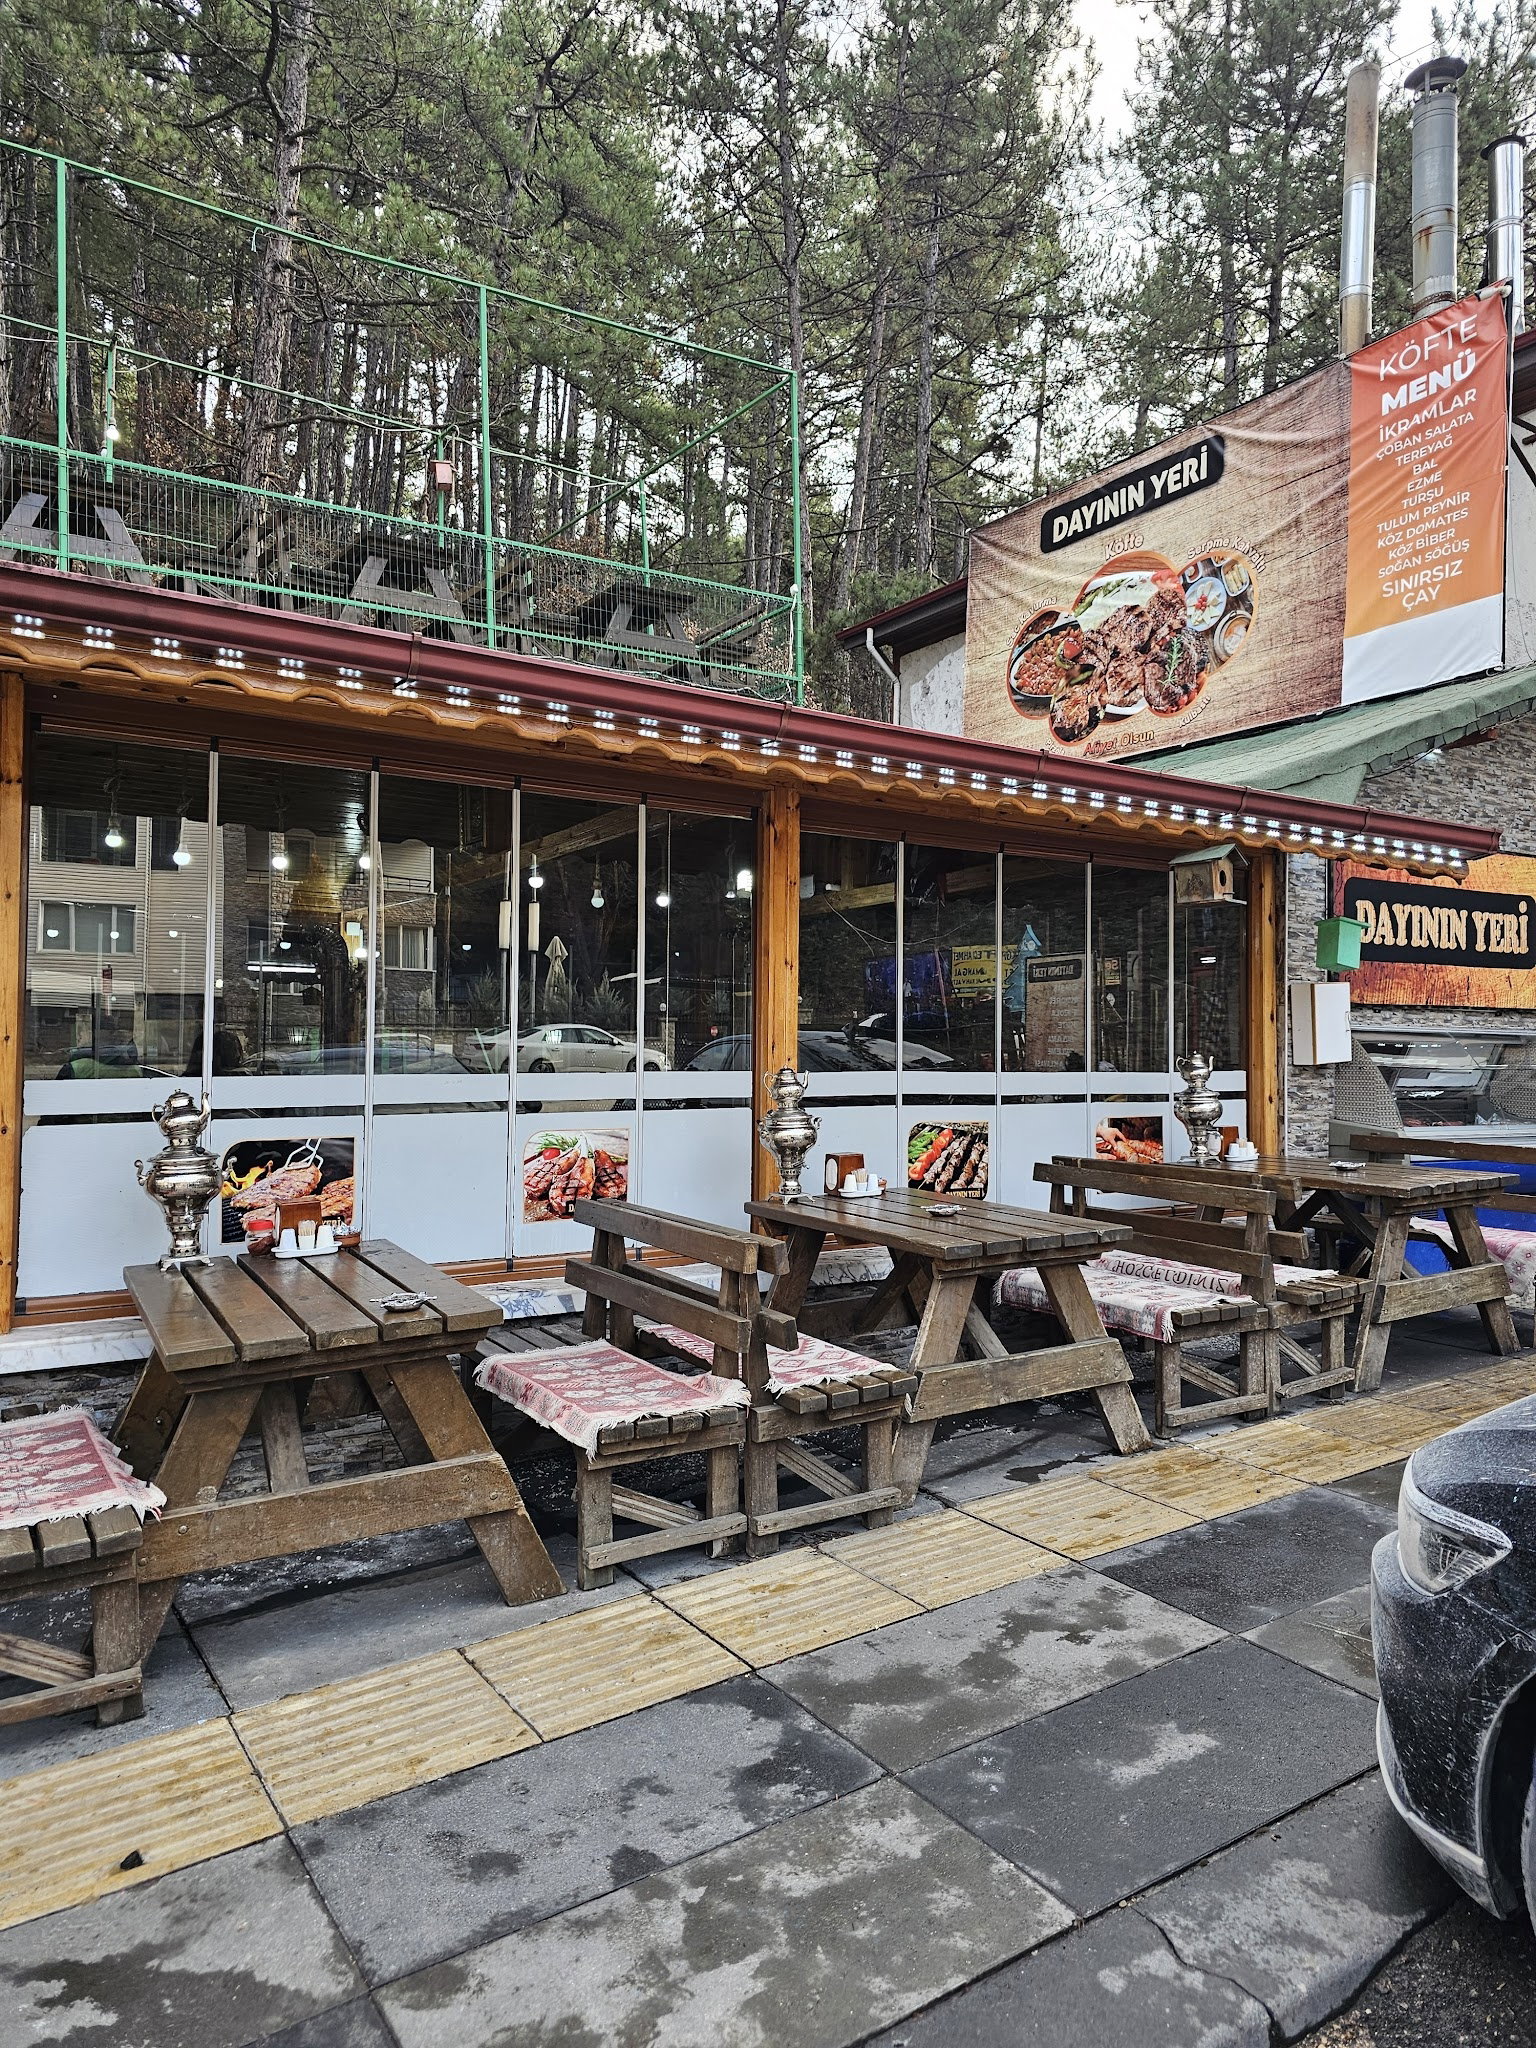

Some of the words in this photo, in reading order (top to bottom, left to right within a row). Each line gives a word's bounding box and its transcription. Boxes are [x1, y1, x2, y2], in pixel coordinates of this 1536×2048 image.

[1380, 313, 1478, 382] KÖFTE
[1381, 348, 1476, 416] MENÜ
[1379, 388, 1477, 443] İKRAMLAR
[1376, 432, 1422, 461] ÇOBAN
[1424, 411, 1474, 440] SALATA
[1395, 433, 1453, 467] TEREYAĞ
[1407, 470, 1443, 493] EZME
[1412, 458, 1438, 476] BAL
[1051, 479, 1145, 544] DAYININ
[1149, 444, 1209, 501] YERİ
[1376, 510, 1420, 534] TULUM
[1423, 491, 1470, 517] PEYNİR
[1401, 485, 1444, 510] TURŞU
[1104, 533, 1145, 561] Köfte
[1377, 531, 1403, 549] KÖZ
[1406, 507, 1469, 539] DOMATES
[1388, 542, 1414, 561] KÖZ
[1416, 527, 1456, 551] BİBER
[1186, 537, 1230, 559] Serpme
[1378, 554, 1422, 579] SOĞAN
[1425, 538, 1471, 563] SÖĞÜŞ
[1382, 559, 1463, 598] SINIRSIZ
[1401, 583, 1441, 612] ÇAY
[1120, 729, 1155, 747] Olsun
[1355, 899, 1468, 951] DAYININ
[1471, 900, 1529, 955] YERİ
